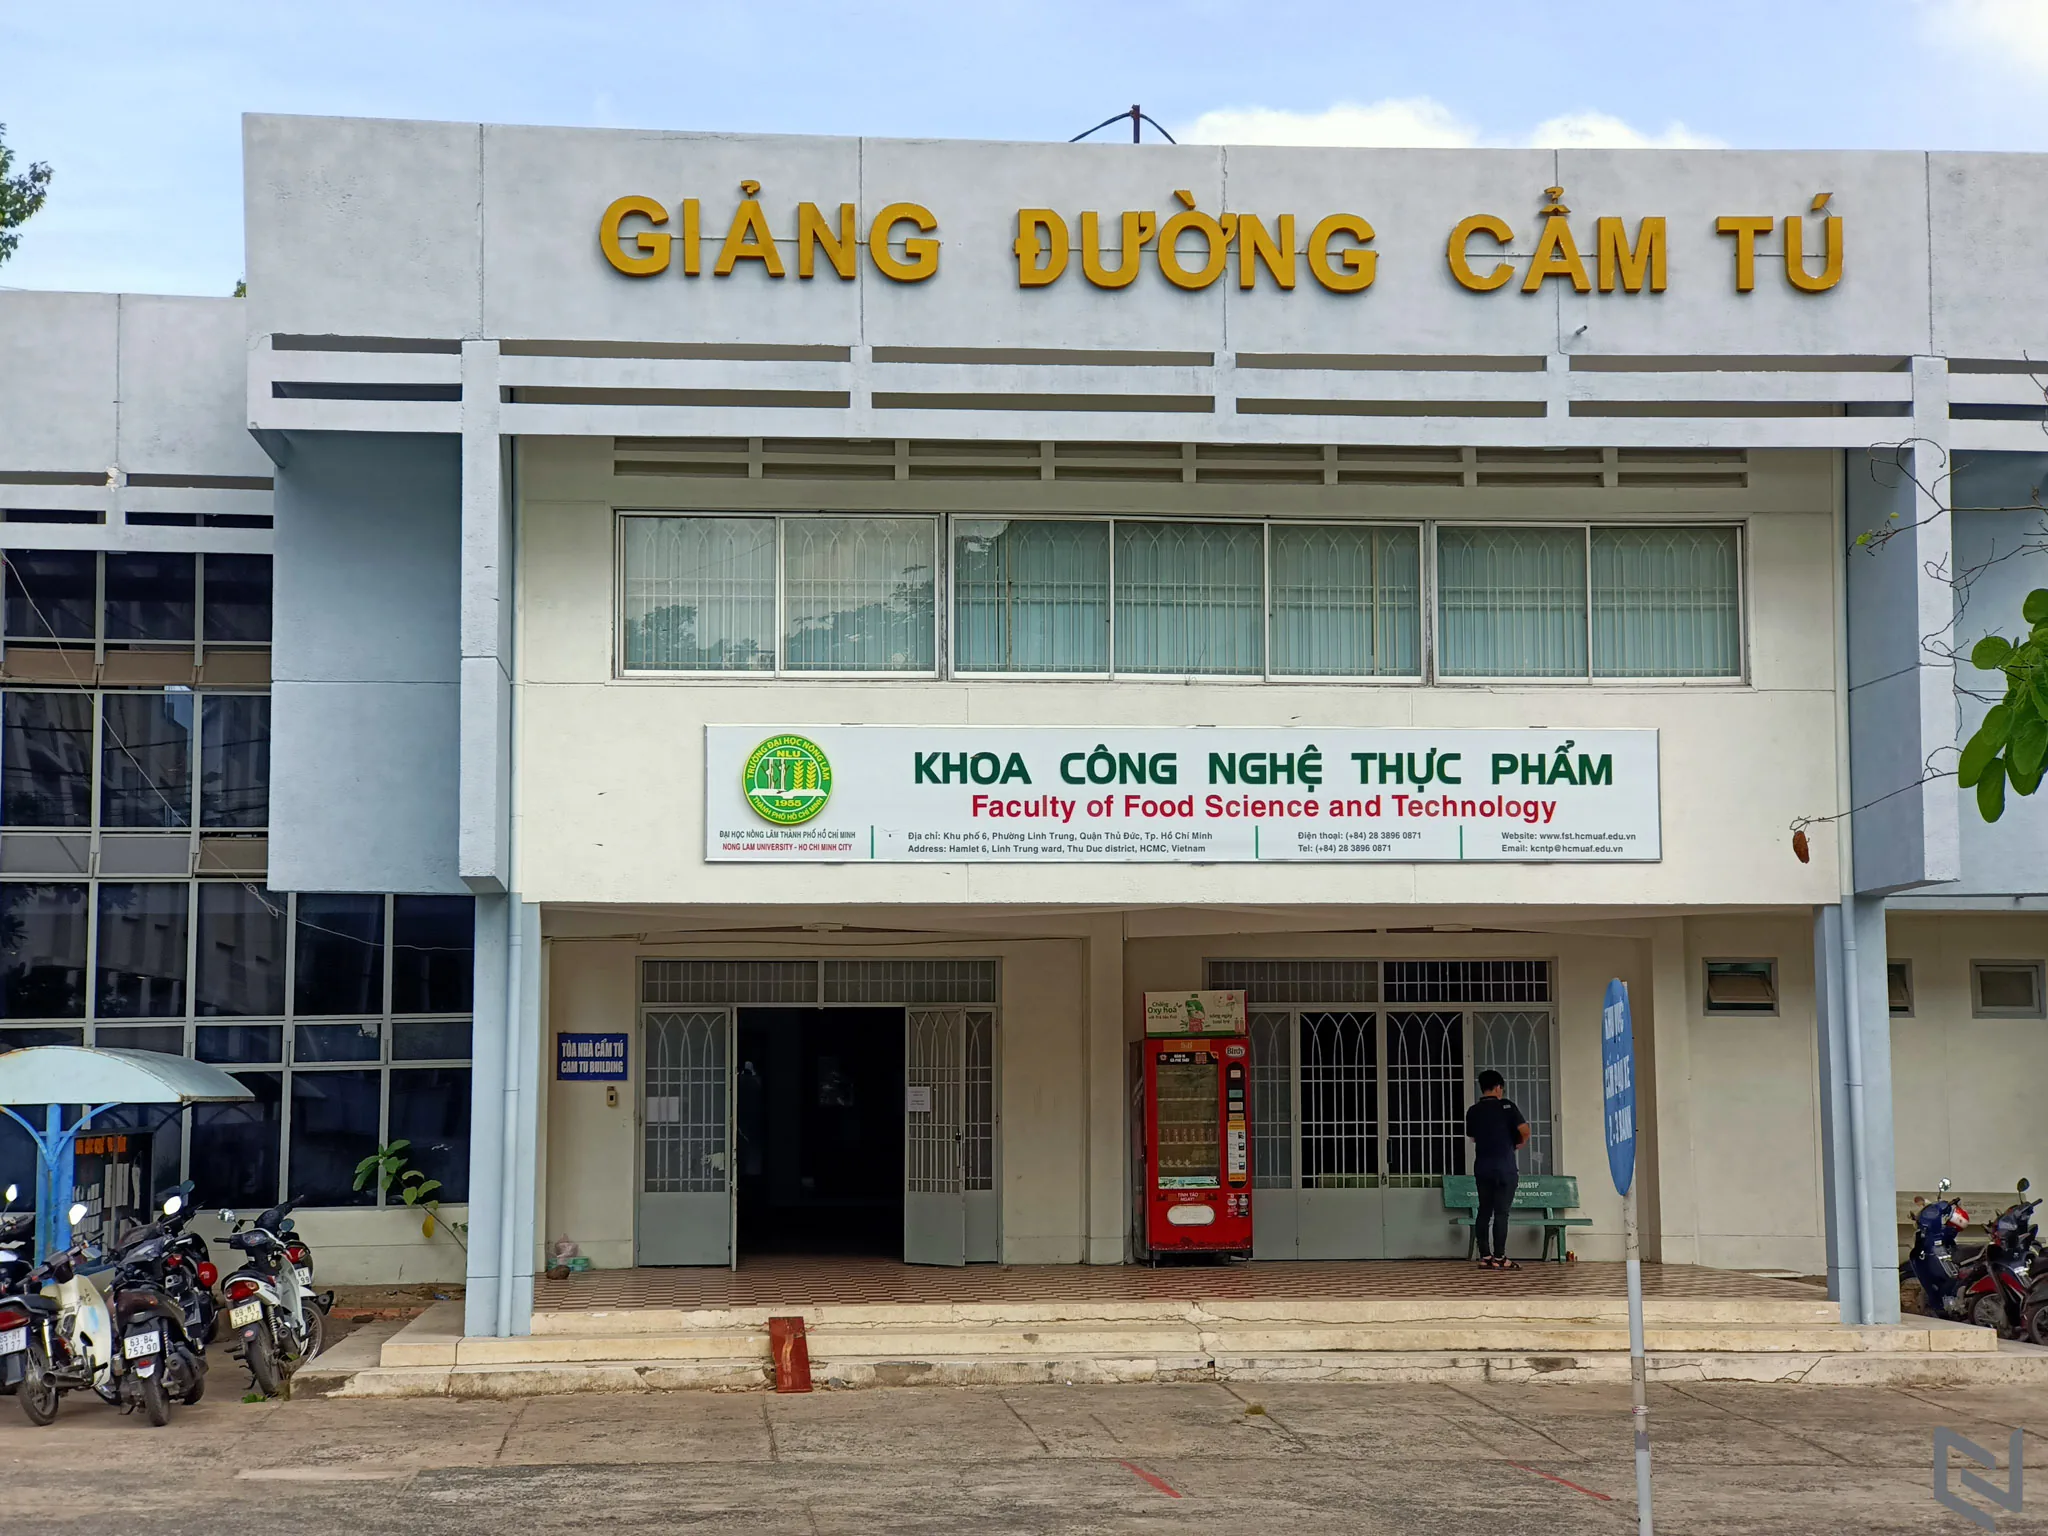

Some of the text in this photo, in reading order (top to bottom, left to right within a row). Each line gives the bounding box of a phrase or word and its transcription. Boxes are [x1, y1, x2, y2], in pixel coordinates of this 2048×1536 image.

[600, 180, 1844, 293] GIẢNG ĐƯỜNG CẨM TÚ
[747, 737, 830, 780] TRƯỜNG ĐẠI HỌC NÔNG LÂM
[914, 740, 1612, 793] KHOA CÔNG NGHỆ THỰC PHẨM
[809, 797, 823, 814] MINH
[972, 795, 1557, 824] Faculty of Food Science and Technology
[719, 830, 730, 840] ĐẠI
[731, 830, 745, 840] HỌC
[766, 829, 779, 839] LÂM
[780, 829, 801, 839] THÀNH
[803, 828, 817, 839] PHỐ
[840, 831, 856, 839] MINH
[907, 831, 1213, 841] Địa chỉ: Khu phố 6, Phường Linh Trung, Quận Thủ Đức, Tp. Hồ Chí Minh
[1298, 832, 1422, 841] Điện thoại: (+84) 28 3896 0871
[1501, 832, 1636, 841] Website: www.fst.hcmuaf.edu.vn
[723, 843, 741, 851] NONG
[742, 843, 755, 851] LAM
[757, 843, 793, 851] UNIVERSITY
[908, 845, 1206, 855] Address: Hamlet 6, Linh Trung ward, Thu Duc district, HCMC, Vietnam
[1298, 844, 1391, 854] Tel: (+84) 28 3896 0871
[1502, 845, 1623, 854] Email: kcntp@hcmuaf.edu.vn
[1147, 1006, 1162, 1015] Oxy
[561, 1040, 577, 1057] TÒA
[578, 1040, 594, 1057] NHÀ
[613, 1039, 624, 1057] TÚ
[1227, 1047, 1243, 1055] Birdy
[561, 1061, 624, 1073] CAM TU BUILDING
